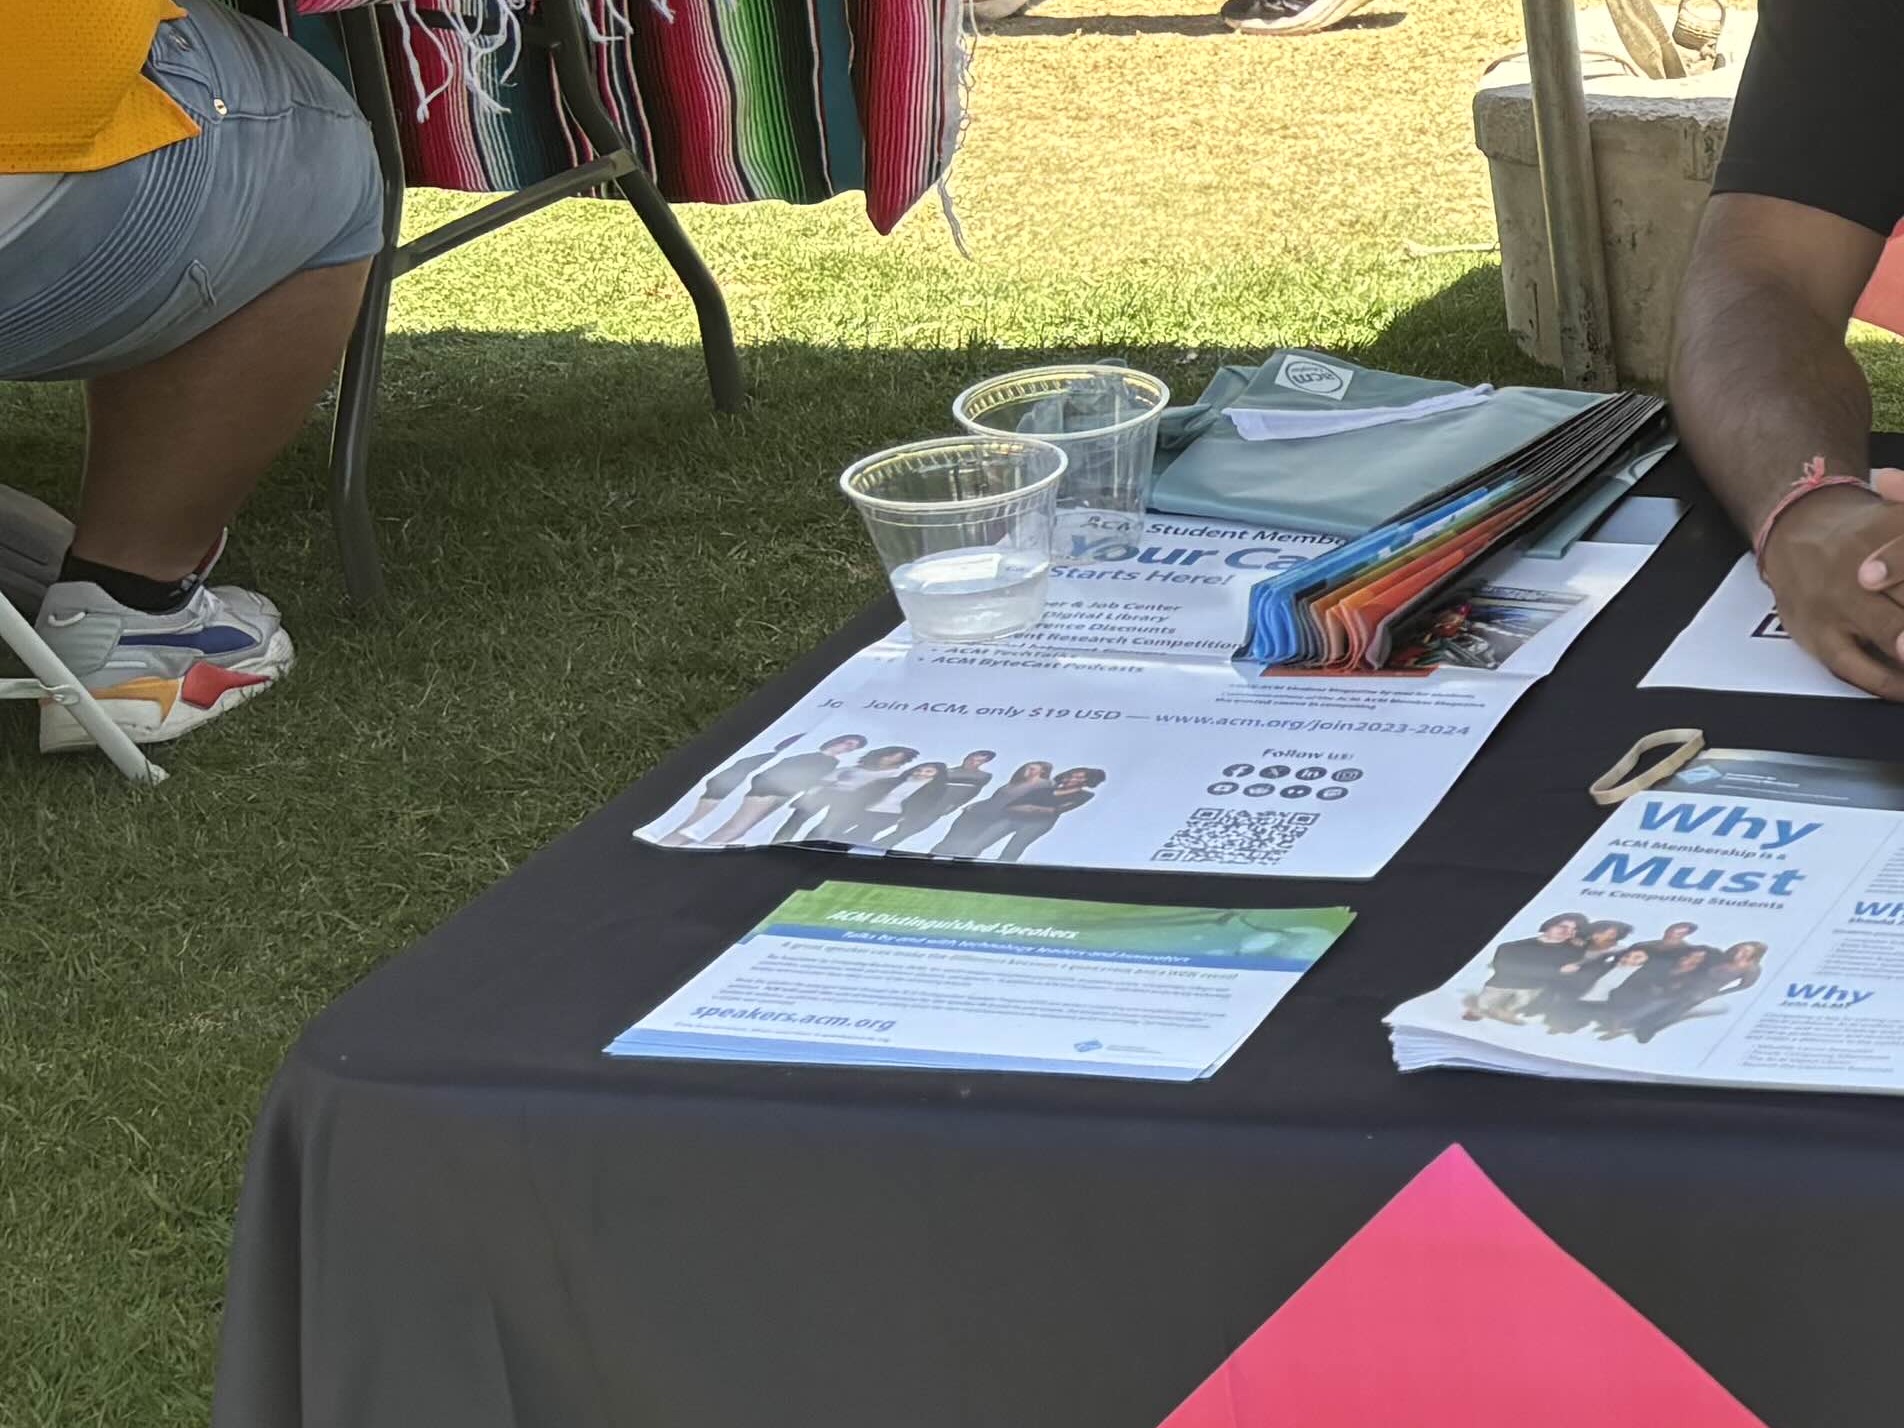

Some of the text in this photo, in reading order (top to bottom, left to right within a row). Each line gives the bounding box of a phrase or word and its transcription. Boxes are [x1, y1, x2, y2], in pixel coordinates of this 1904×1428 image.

[1146, 522, 1250, 541] Student
[1049, 564, 1235, 587] Starts Here!
[864, 698, 909, 711] Join
[913, 701, 968, 716] ACM,
[975, 704, 1023, 718] only
[1028, 707, 1070, 718] $19
[1074, 708, 1121, 721] USD
[1639, 800, 1826, 851] Why
[1607, 838, 1650, 850] ACM
[1650, 841, 1757, 860] Membership
[1581, 852, 1807, 896] Must
[1607, 889, 1708, 905] Computing
[1708, 896, 1786, 910] Students
[826, 909, 874, 924] ACM
[992, 922, 1081, 941] Speakers
[1786, 982, 1876, 1005] Why
[689, 1004, 898, 1032] speakers.acm.org
